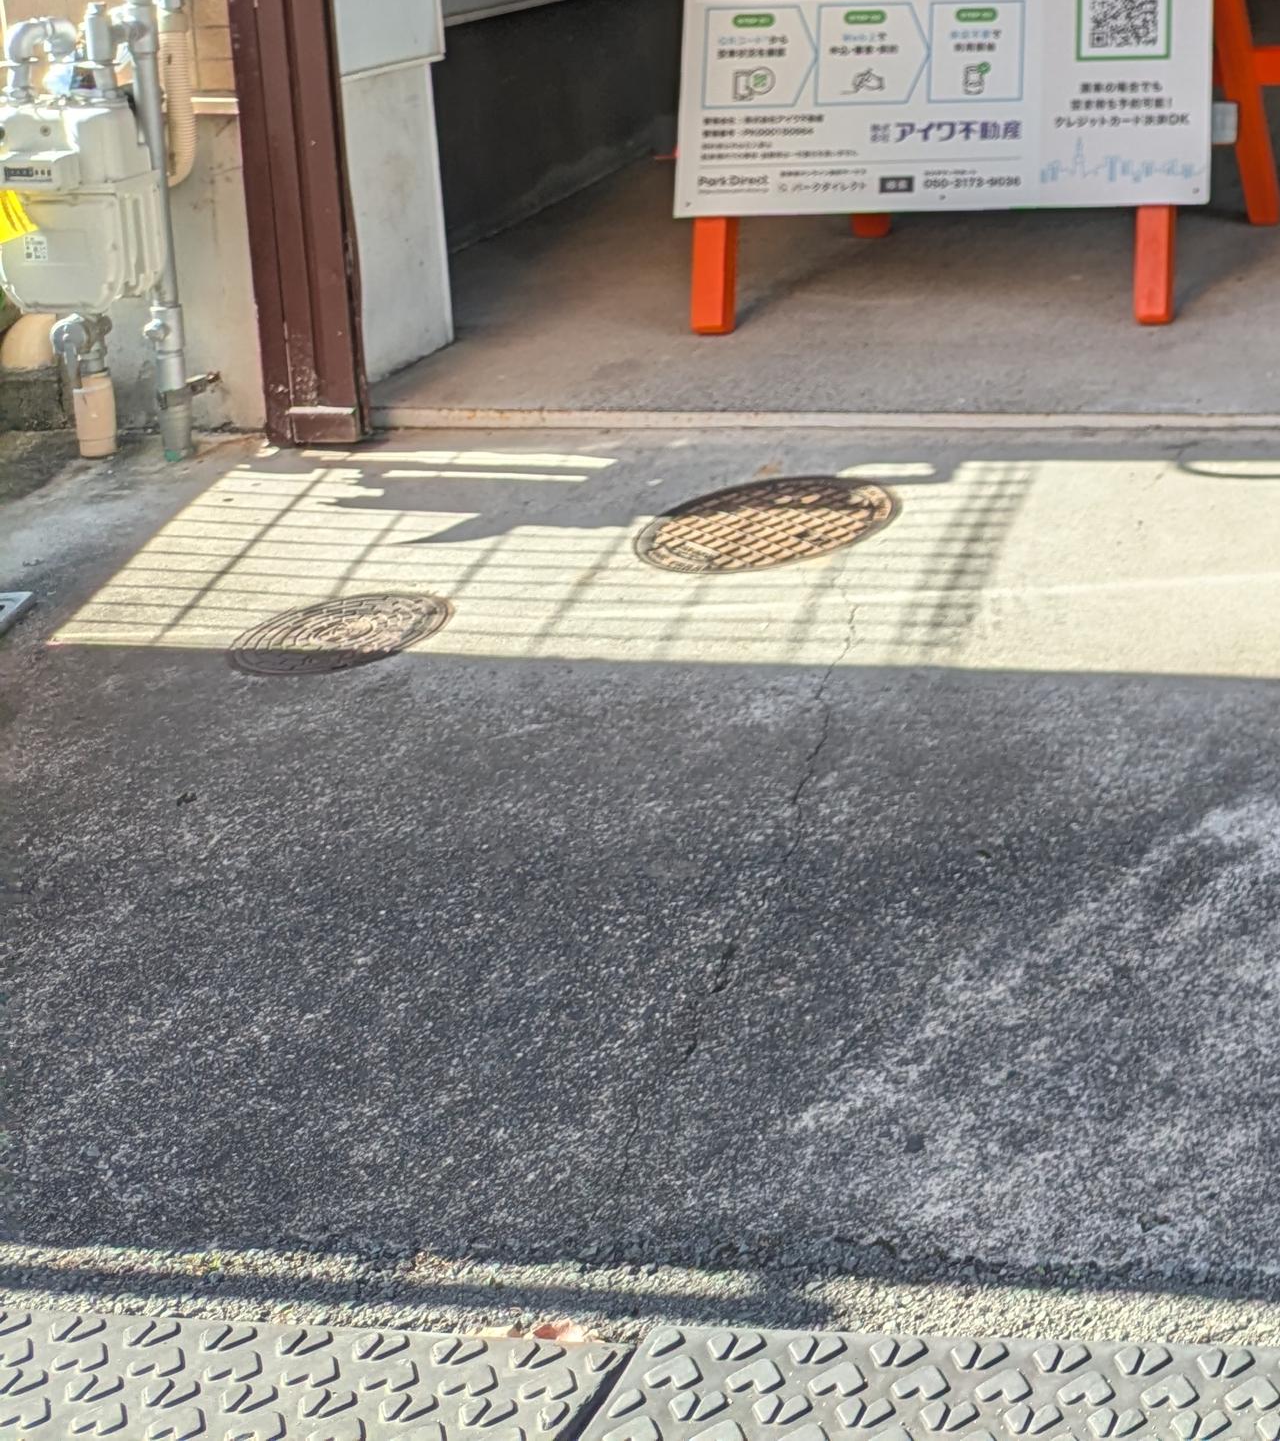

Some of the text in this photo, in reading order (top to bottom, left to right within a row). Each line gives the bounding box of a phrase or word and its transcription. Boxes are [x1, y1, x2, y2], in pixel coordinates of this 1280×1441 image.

[894, 120, 1023, 143] アイワ不動産
